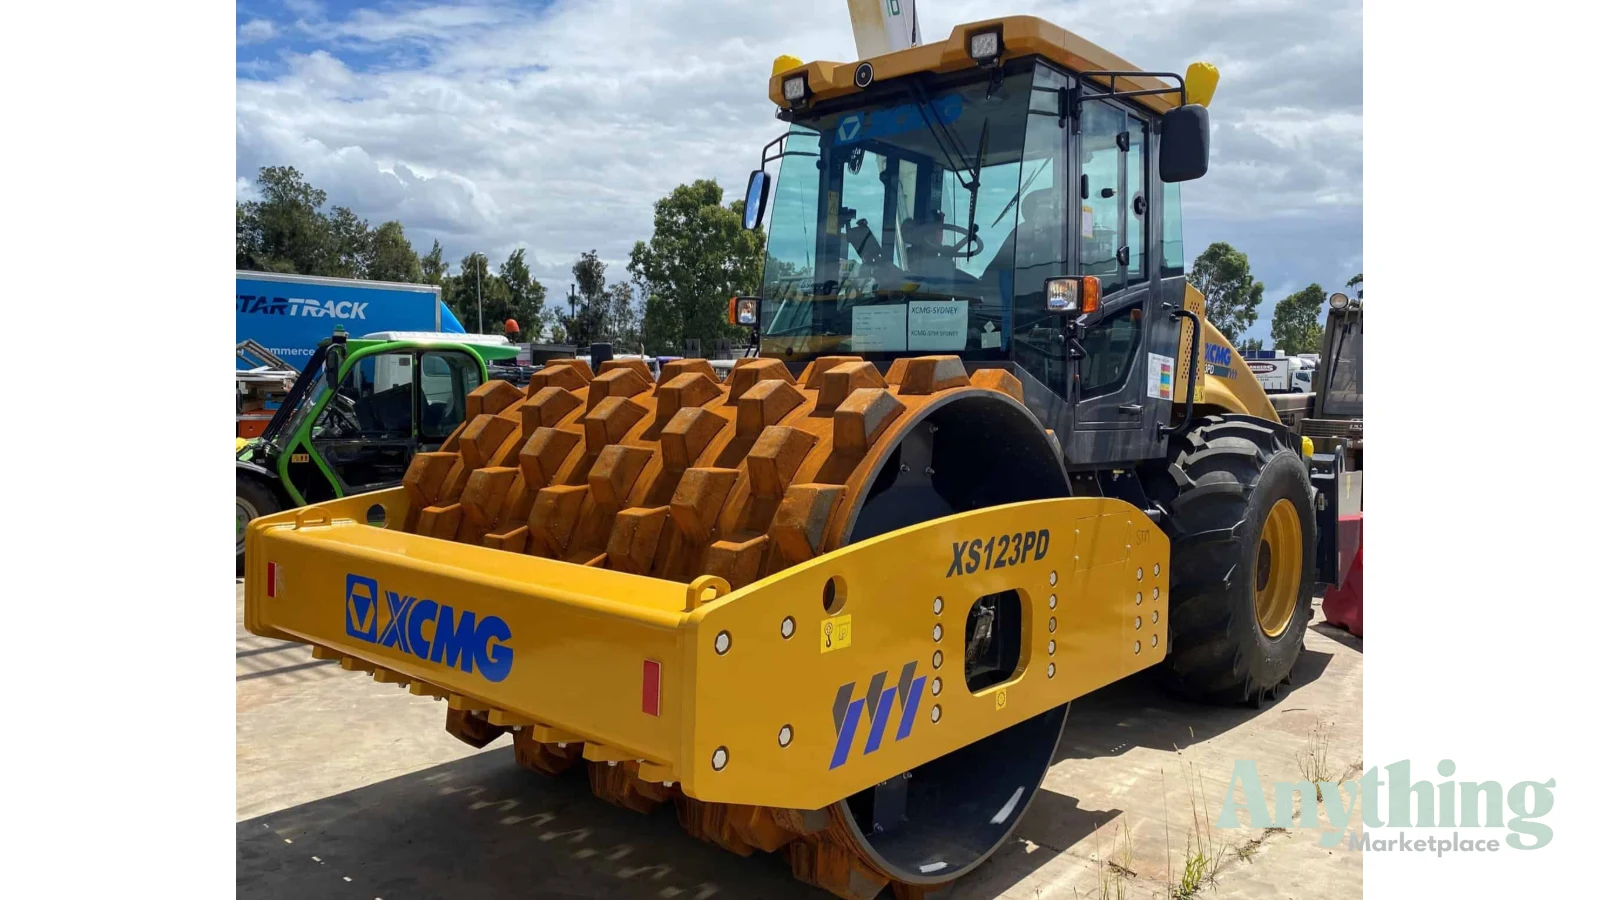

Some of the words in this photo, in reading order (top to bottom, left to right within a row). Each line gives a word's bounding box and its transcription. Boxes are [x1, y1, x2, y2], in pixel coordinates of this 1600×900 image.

[236, 294, 369, 319] TARTRACK
[946, 529, 1050, 578] XS123PD
[377, 590, 514, 682] XCMG
